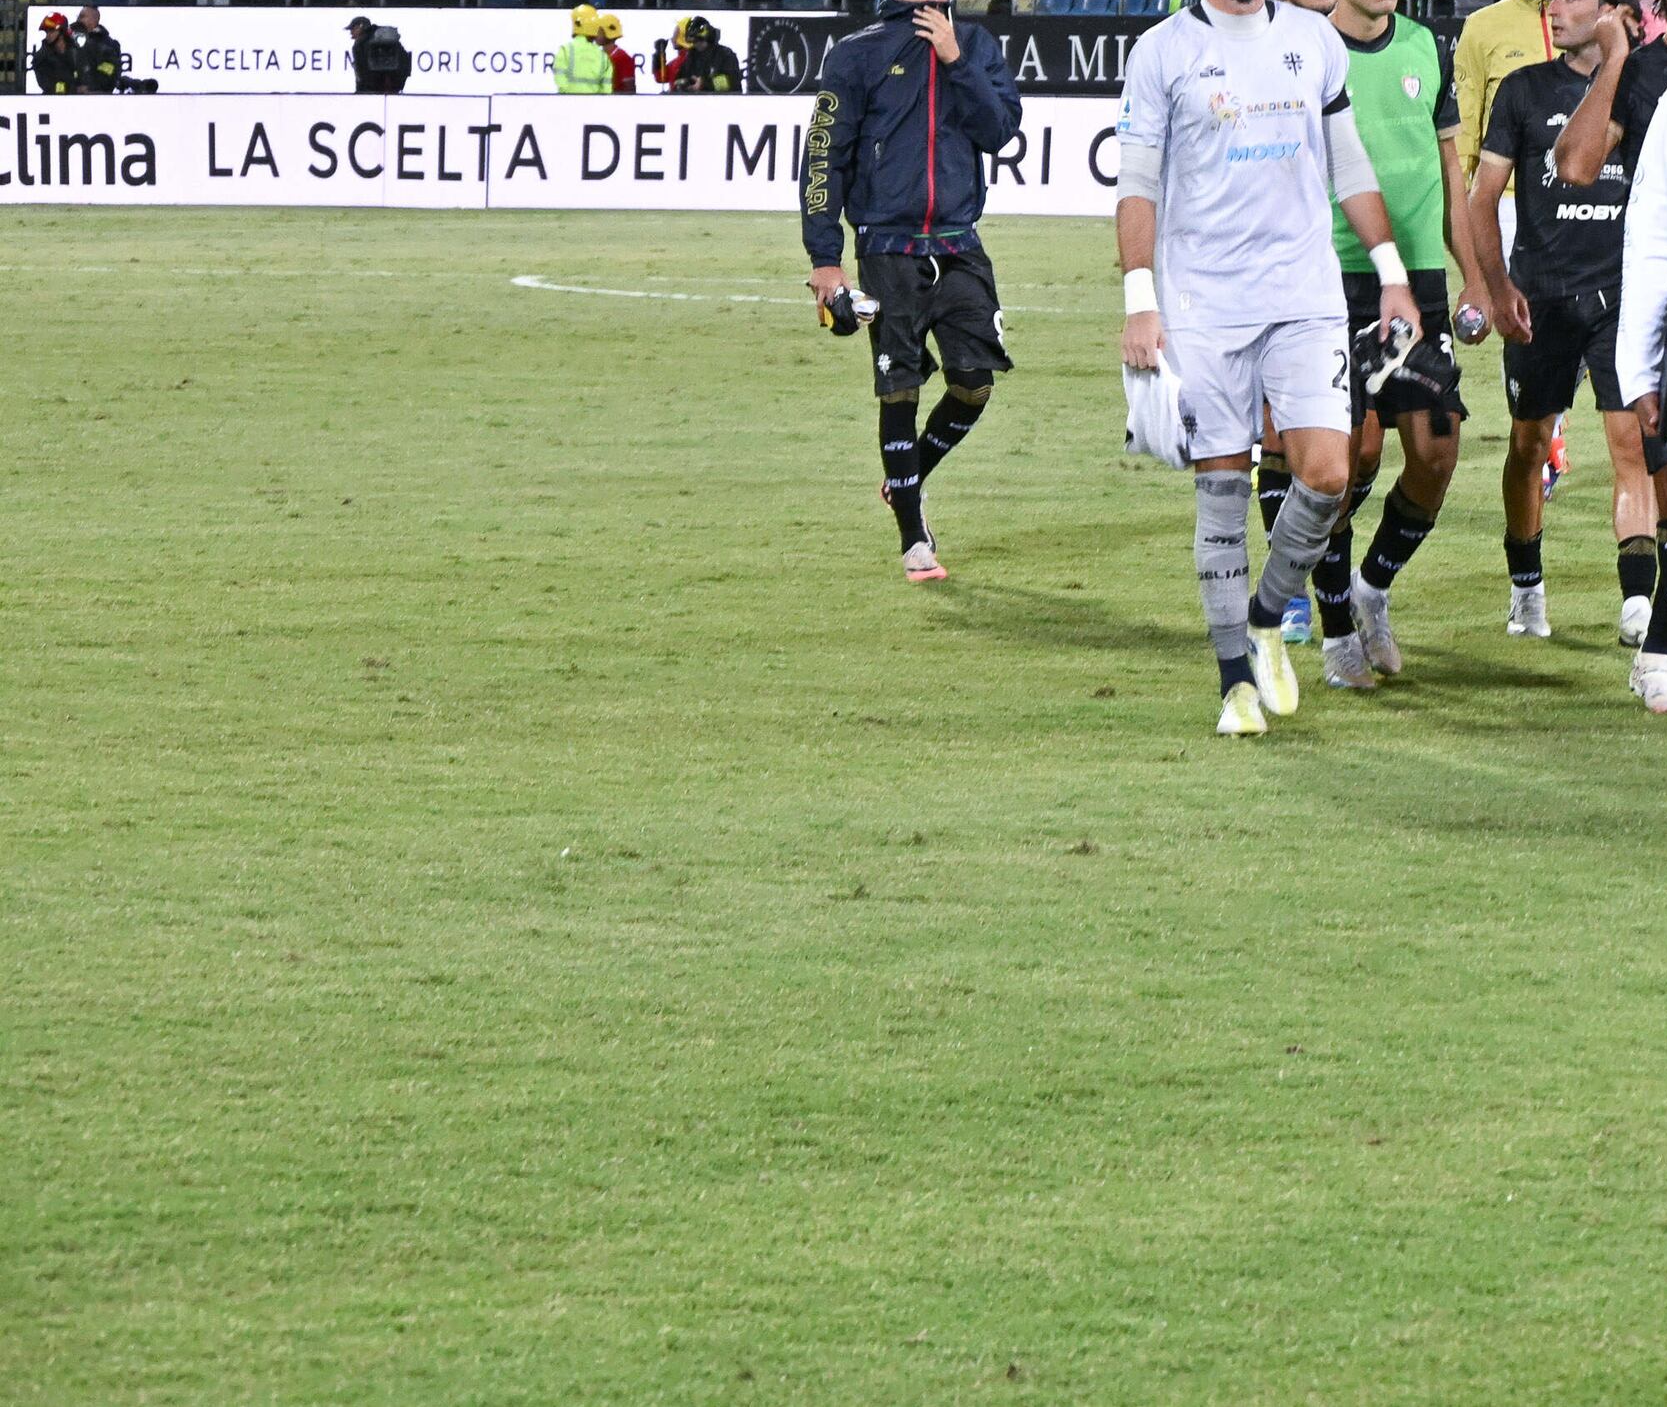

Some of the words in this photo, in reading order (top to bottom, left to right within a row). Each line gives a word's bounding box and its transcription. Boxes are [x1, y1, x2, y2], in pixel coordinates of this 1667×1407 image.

[153, 49, 181, 71] LA
[191, 49, 280, 71] SCELTA
[292, 50, 332, 71] DEI
[0, 112, 157, 187] lima
[208, 122, 280, 178] LA
[308, 121, 548, 182] SCELTA
[581, 123, 689, 181] DEI
[805, 90, 840, 216] CAGLIARI
[1227, 142, 1302, 163] MOBY
[1556, 204, 1623, 221] MOBY
